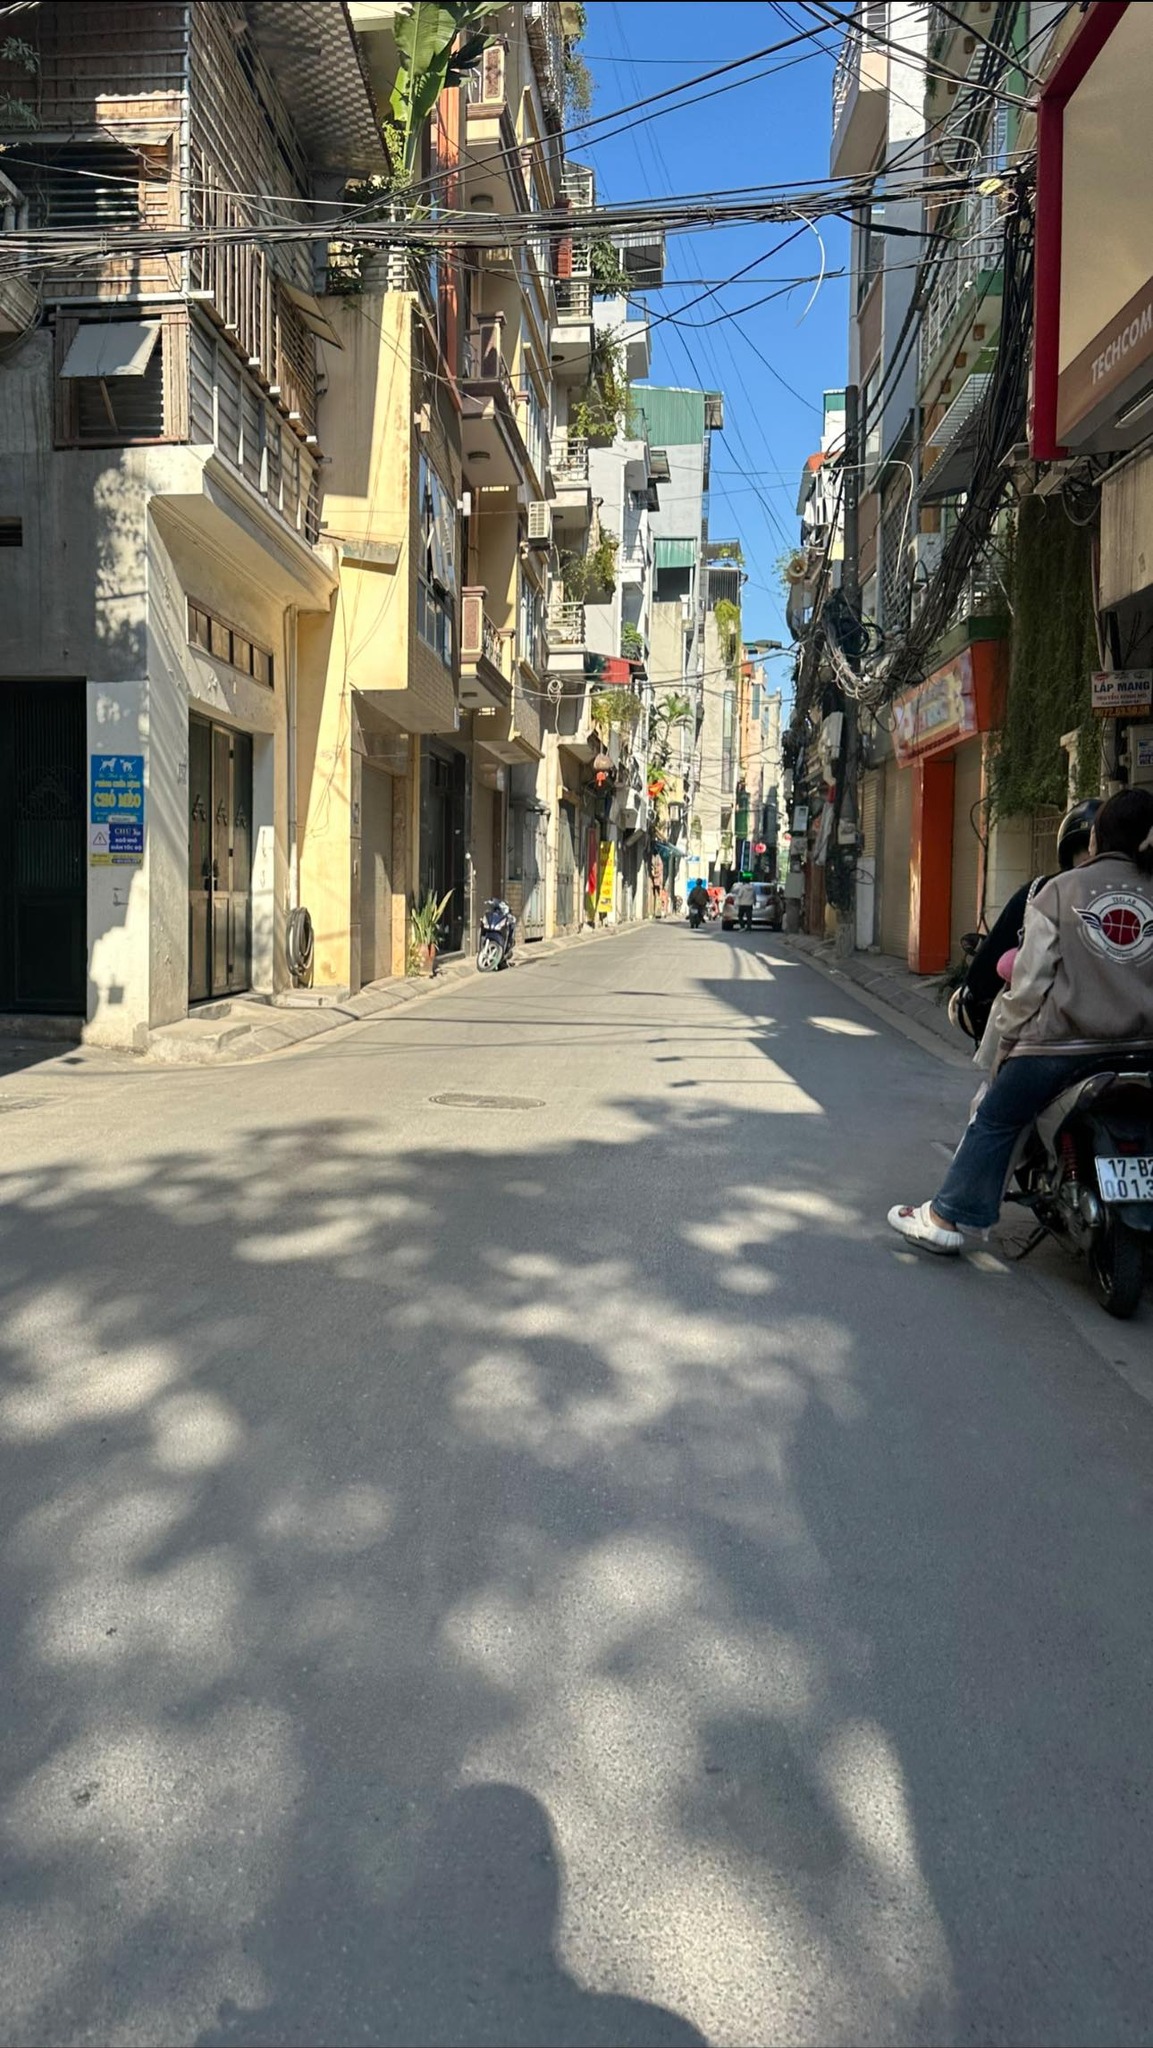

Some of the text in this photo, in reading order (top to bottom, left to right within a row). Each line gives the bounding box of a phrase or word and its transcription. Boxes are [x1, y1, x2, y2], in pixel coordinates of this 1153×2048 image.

[1091, 303, 1152, 386] TECHCOM
[1117, 681, 1150, 693] MẠNG
[94, 789, 141, 808] CHÓ MÈO
